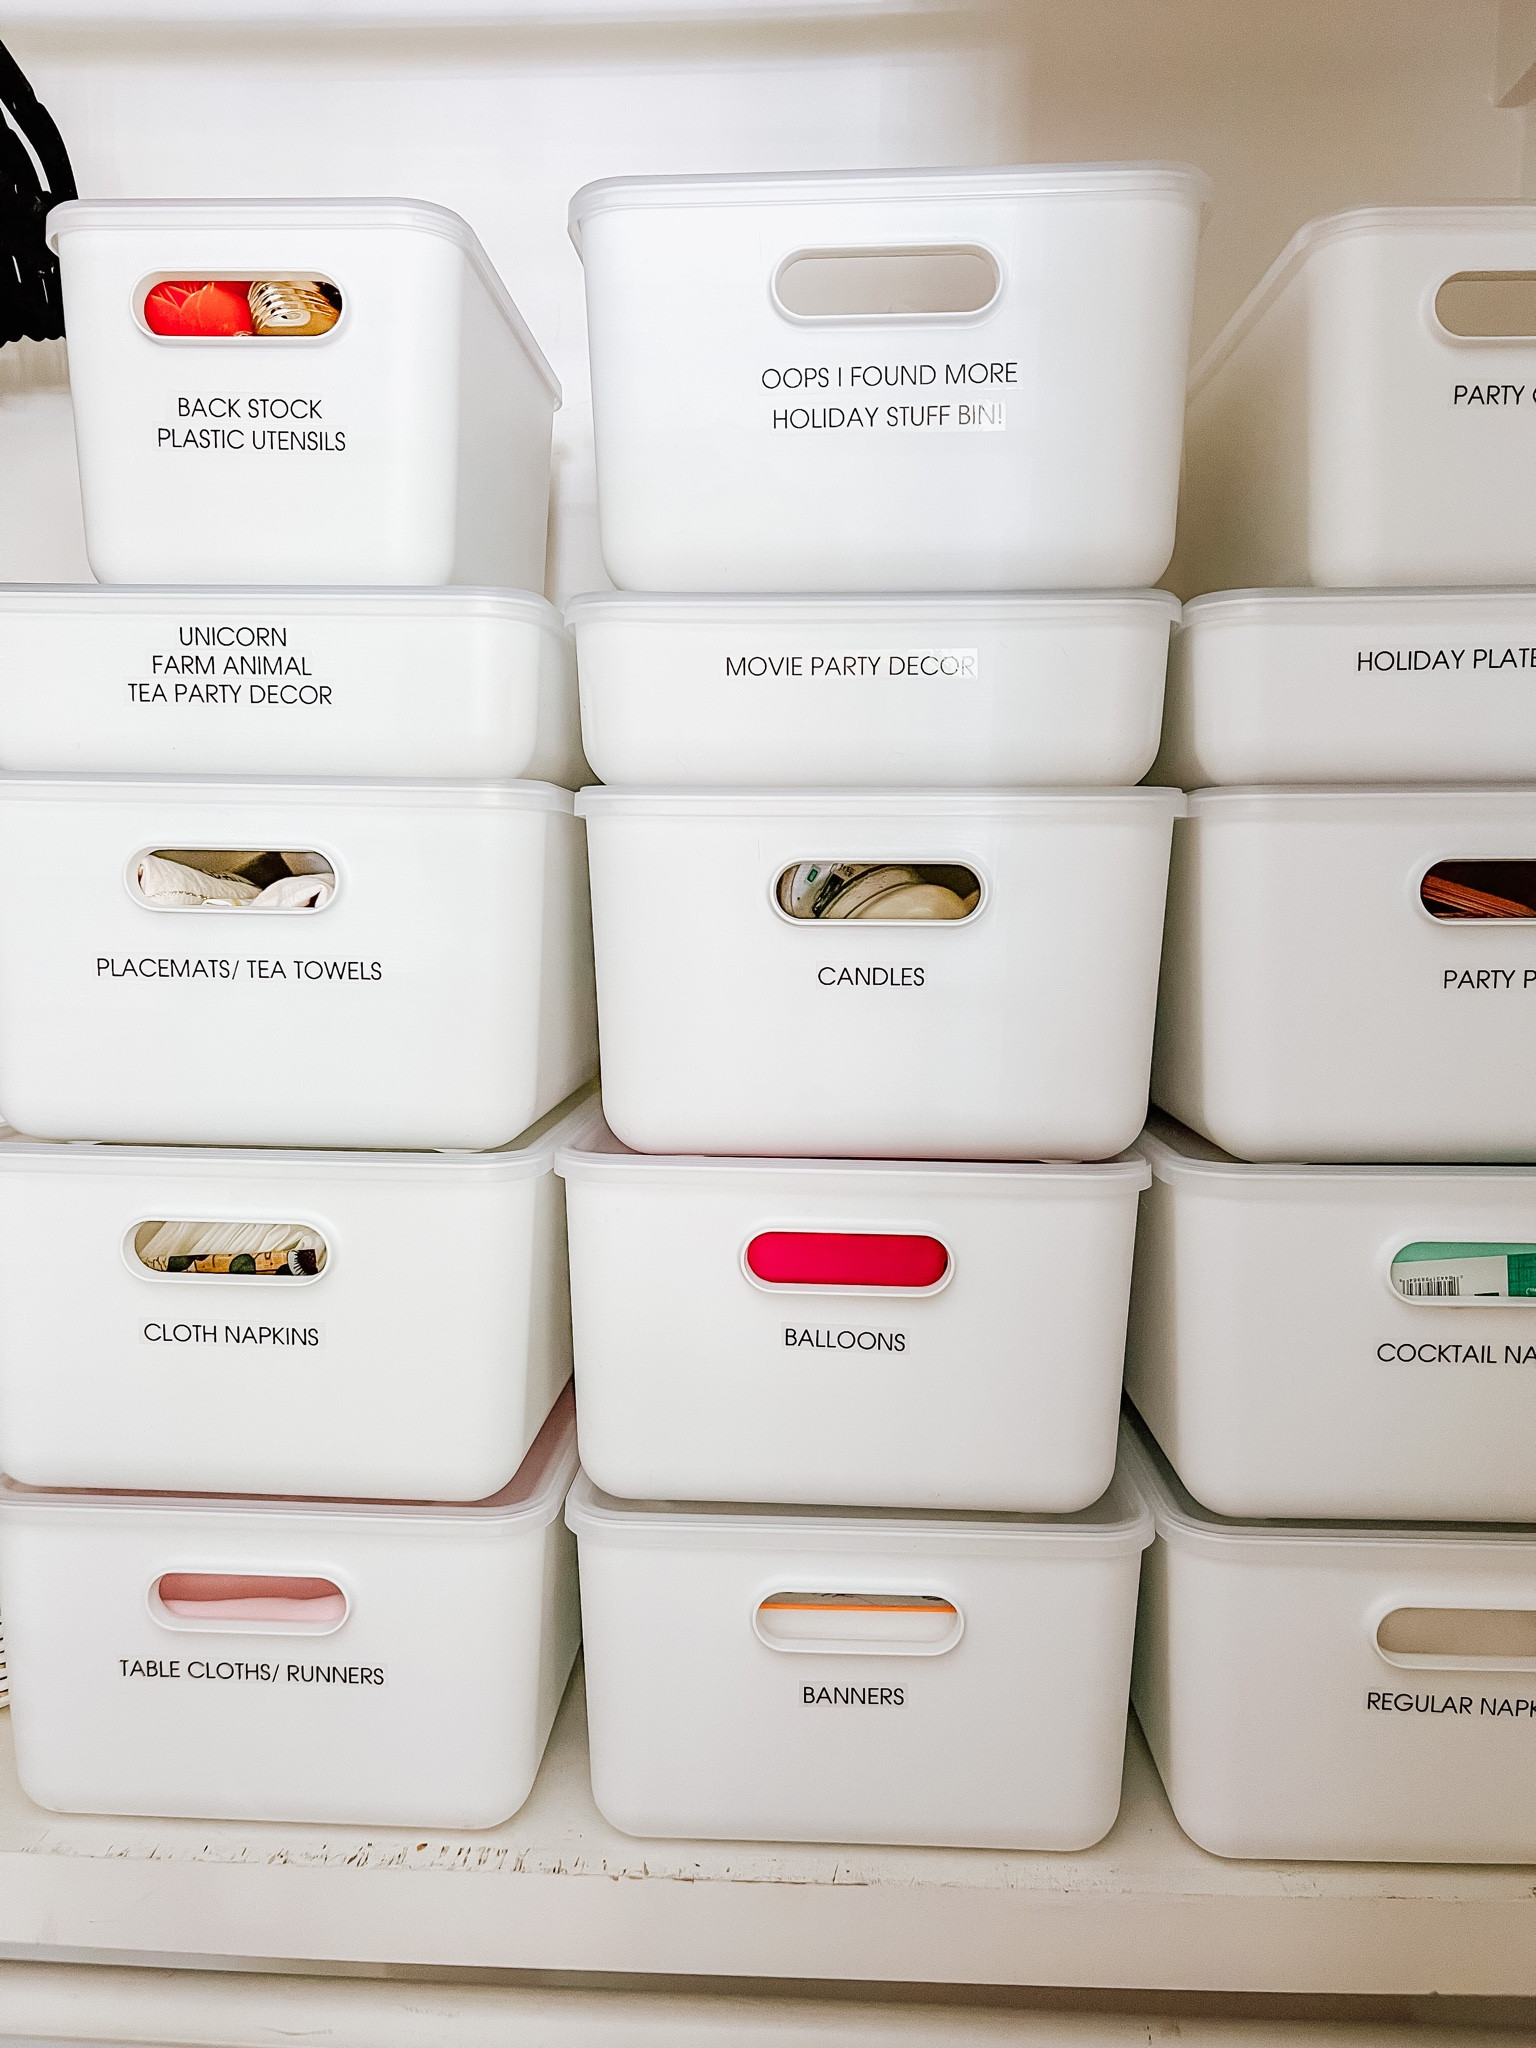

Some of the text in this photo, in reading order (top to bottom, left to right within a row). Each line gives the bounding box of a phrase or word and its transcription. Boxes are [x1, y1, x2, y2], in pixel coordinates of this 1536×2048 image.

[762, 363, 1018, 389] OOPS I FOUND MORE
[1454, 385, 1525, 405] PARTY
[178, 398, 322, 419] BACK STOCK
[774, 404, 1002, 429] HOLIDAY STUFF BIN!
[158, 428, 345, 451] PLASTIC UTENSILS
[180, 627, 286, 646] UNICORN
[153, 655, 312, 675] FARM ANIMAL
[727, 655, 975, 677] MOVIE PARTY DECOR
[1358, 650, 1465, 671] HOLIDAY
[128, 683, 332, 704] TEA PARTY DECOR
[97, 958, 382, 980] PLACEMATS/ TEA TOWELS
[818, 967, 924, 986] CANDLES
[1444, 970, 1515, 989] PARTY
[144, 1323, 318, 1346] CLOTH NAPKINS
[785, 1328, 905, 1351] BALLOONS
[1377, 1343, 1497, 1363] COCKTAIL
[119, 1660, 384, 1685] TABLE CLOTHS/ RUNNERS
[804, 1687, 904, 1706] BANNERS
[1368, 1692, 1473, 1714] REGULAR
